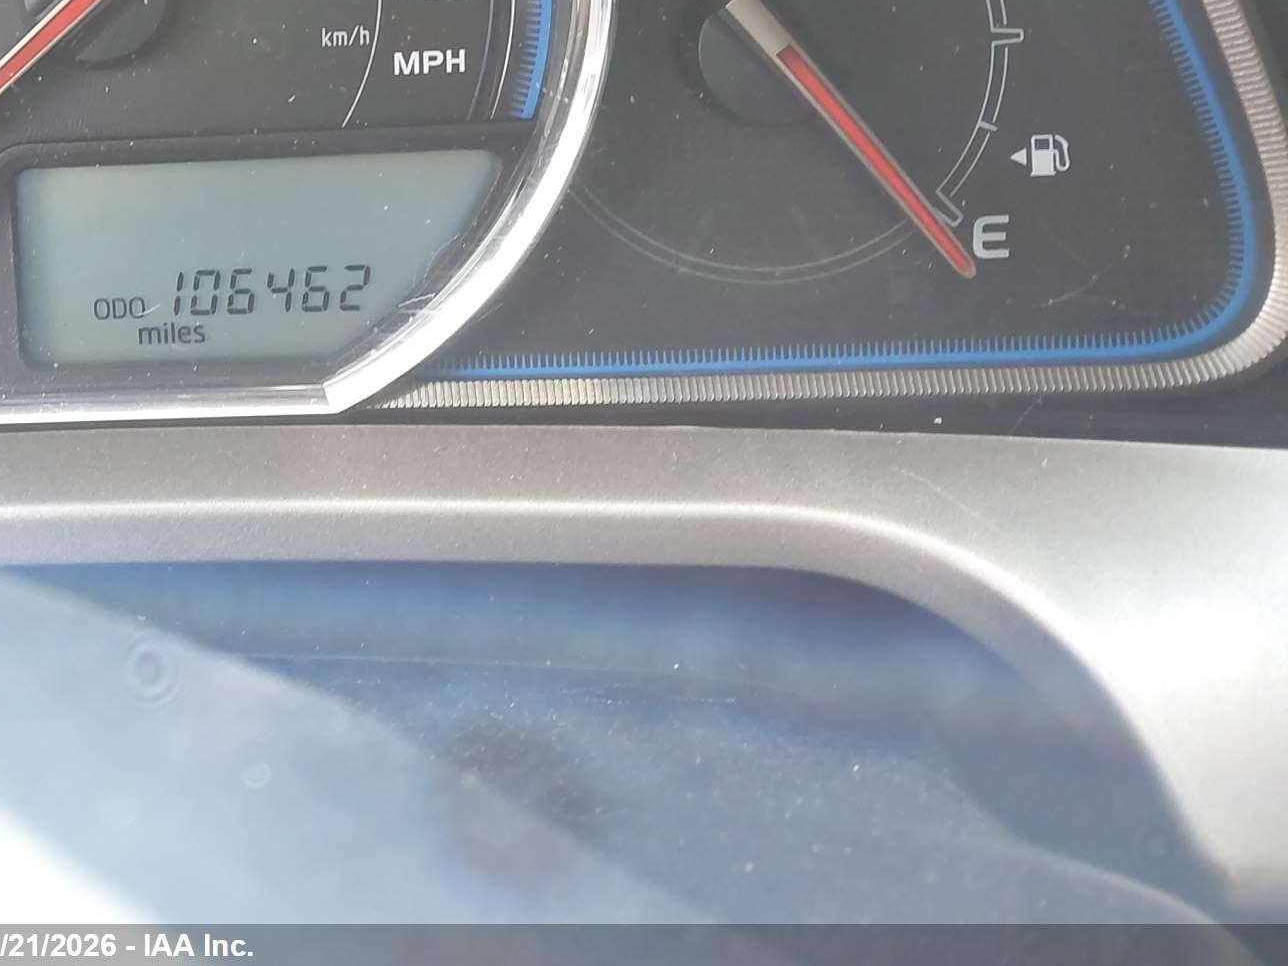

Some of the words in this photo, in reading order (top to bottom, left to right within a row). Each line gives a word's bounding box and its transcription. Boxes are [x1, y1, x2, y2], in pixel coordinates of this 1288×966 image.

[321, 25, 371, 50] km/h
[393, 49, 466, 77] MPH
[973, 215, 1010, 259] E
[93, 297, 146, 321] ODO
[172, 264, 372, 317] 106462
[138, 320, 207, 347] miles
